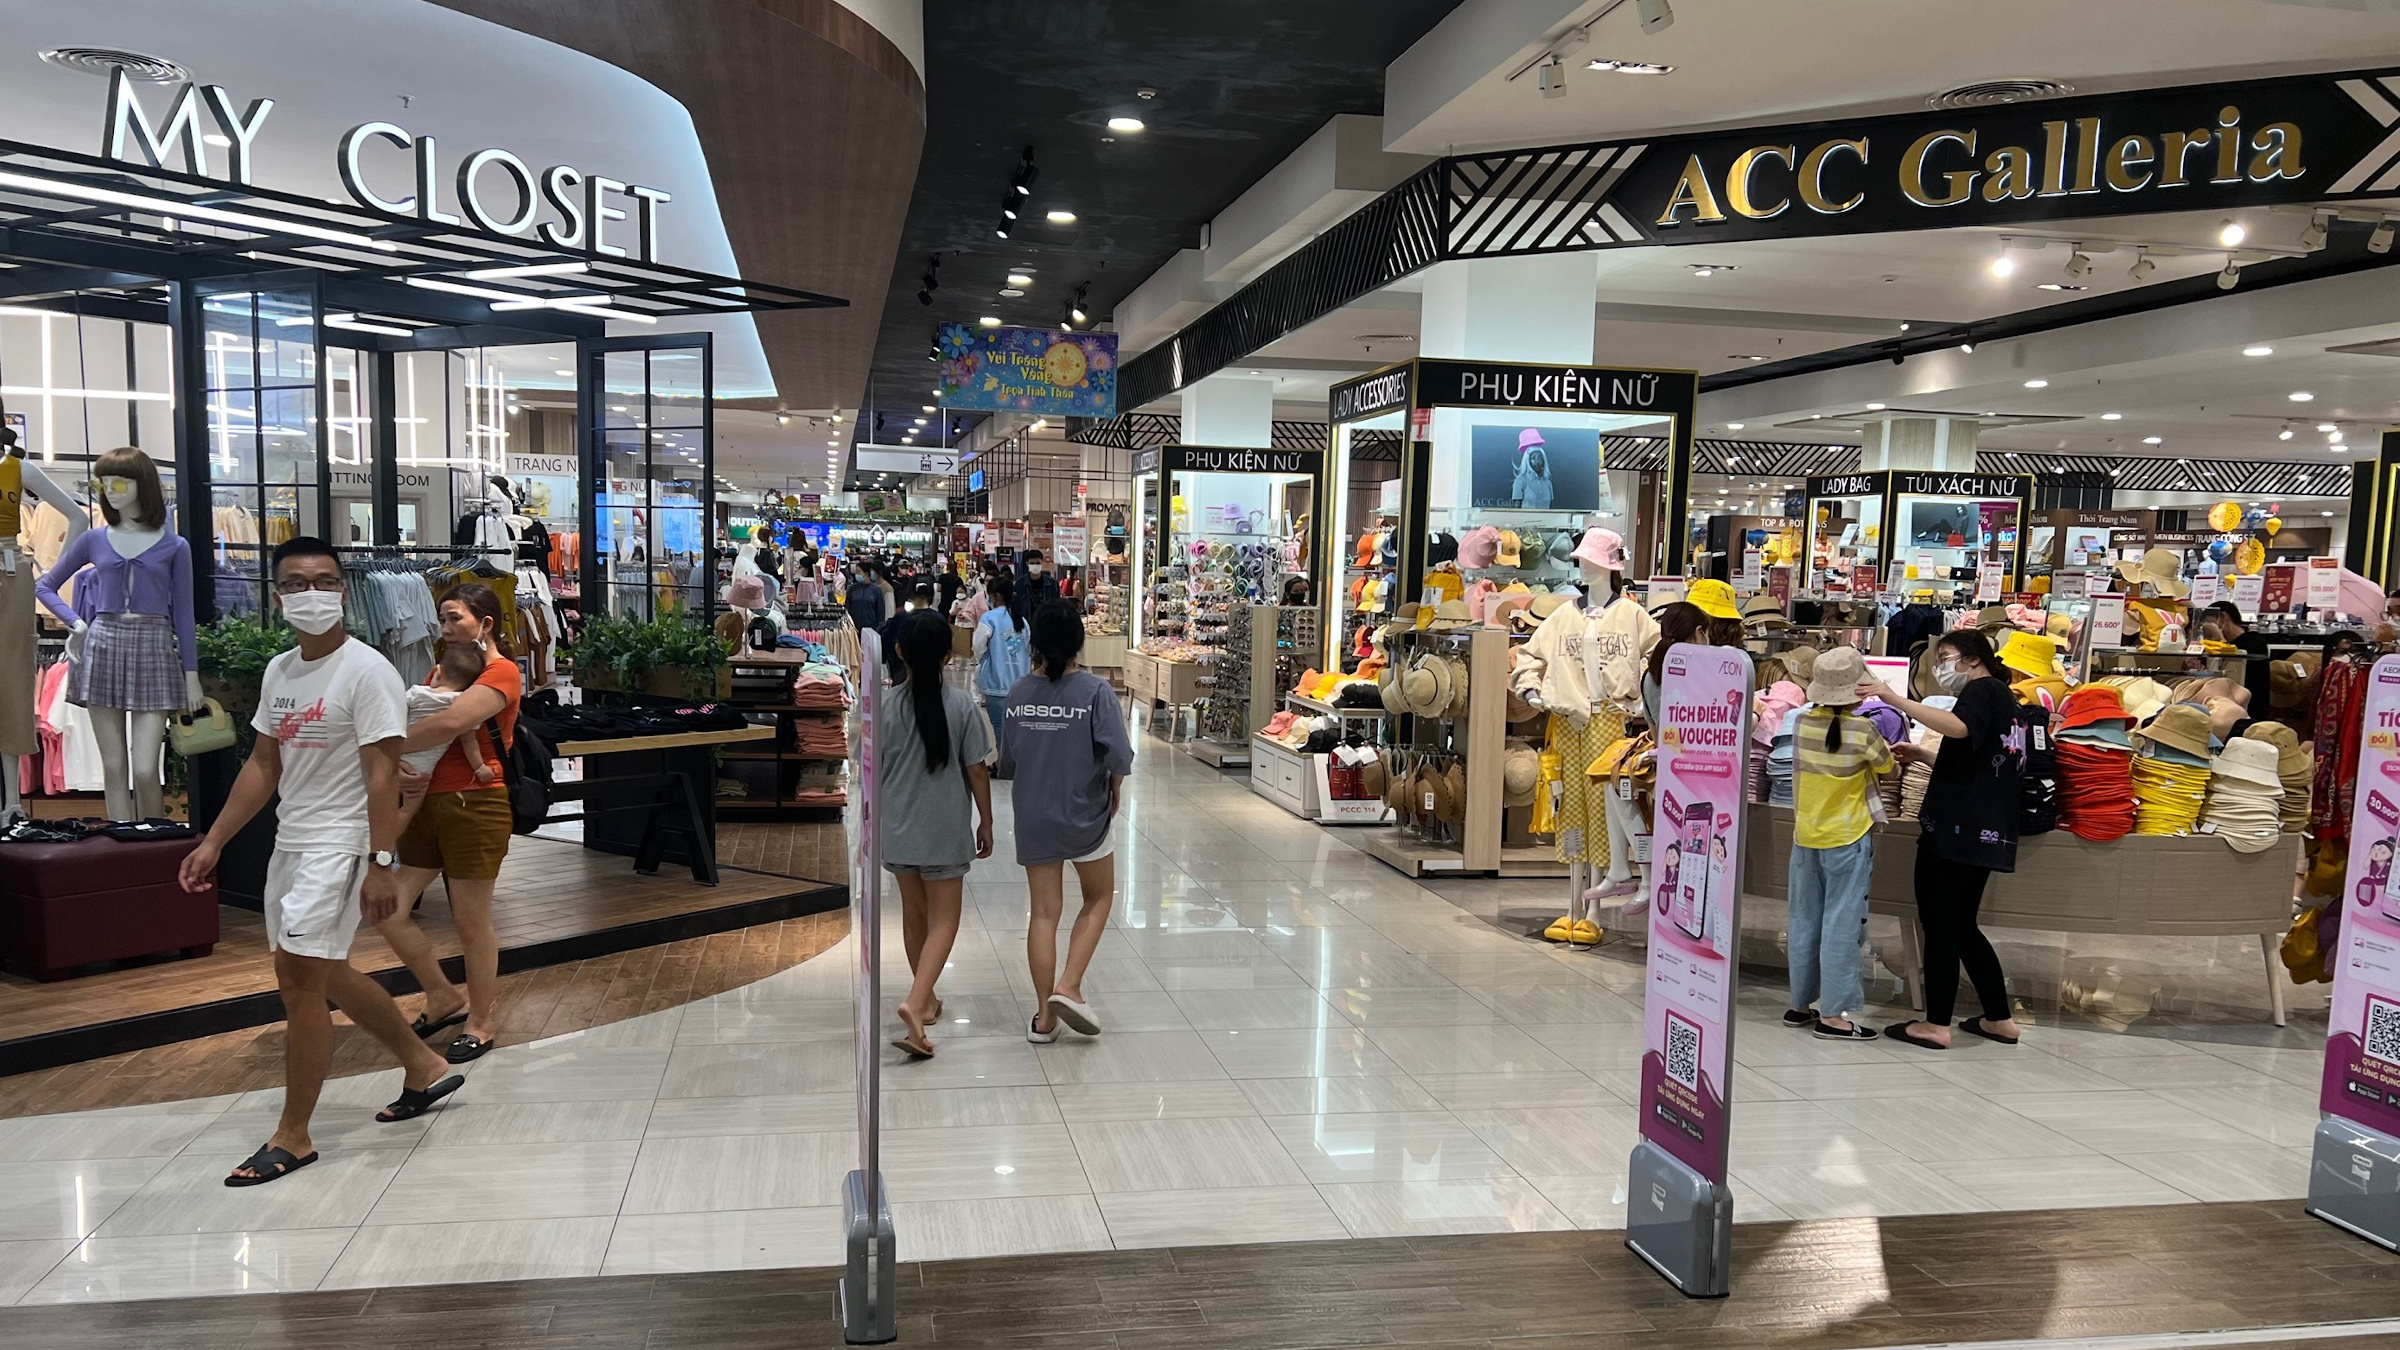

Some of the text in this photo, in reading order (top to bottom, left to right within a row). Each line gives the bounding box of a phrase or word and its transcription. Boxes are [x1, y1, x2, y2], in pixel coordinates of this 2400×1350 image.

[102, 66, 671, 264] MY CLOSET
[1656, 104, 2307, 229] ACC Galleria
[1334, 371, 1407, 419] LADY ACCESSORIES
[1461, 368, 1660, 407] PHỤ KIỆN NỮ
[514, 457, 562, 472] TRANG
[567, 459, 577, 472] N
[1185, 449, 1302, 471] PHỤ KIỆN NỮ
[396, 474, 430, 487] OOM
[1821, 475, 1872, 494] LADY BAG
[1905, 474, 2018, 496] TÚI XÁCH NỮ
[1761, 517, 1777, 527] TOP
[1779, 517, 1786, 527] &
[2098, 514, 2119, 526] Trang
[2120, 515, 2138, 524] Nam
[829, 526, 869, 541] SPORTS
[886, 530, 931, 542] ACTIVITY
[2382, 665, 2400, 674] AEO
[273, 697, 296, 709] 2014
[1668, 701, 1696, 722] TÍCH
[1678, 727, 1738, 747] VOUCHER
